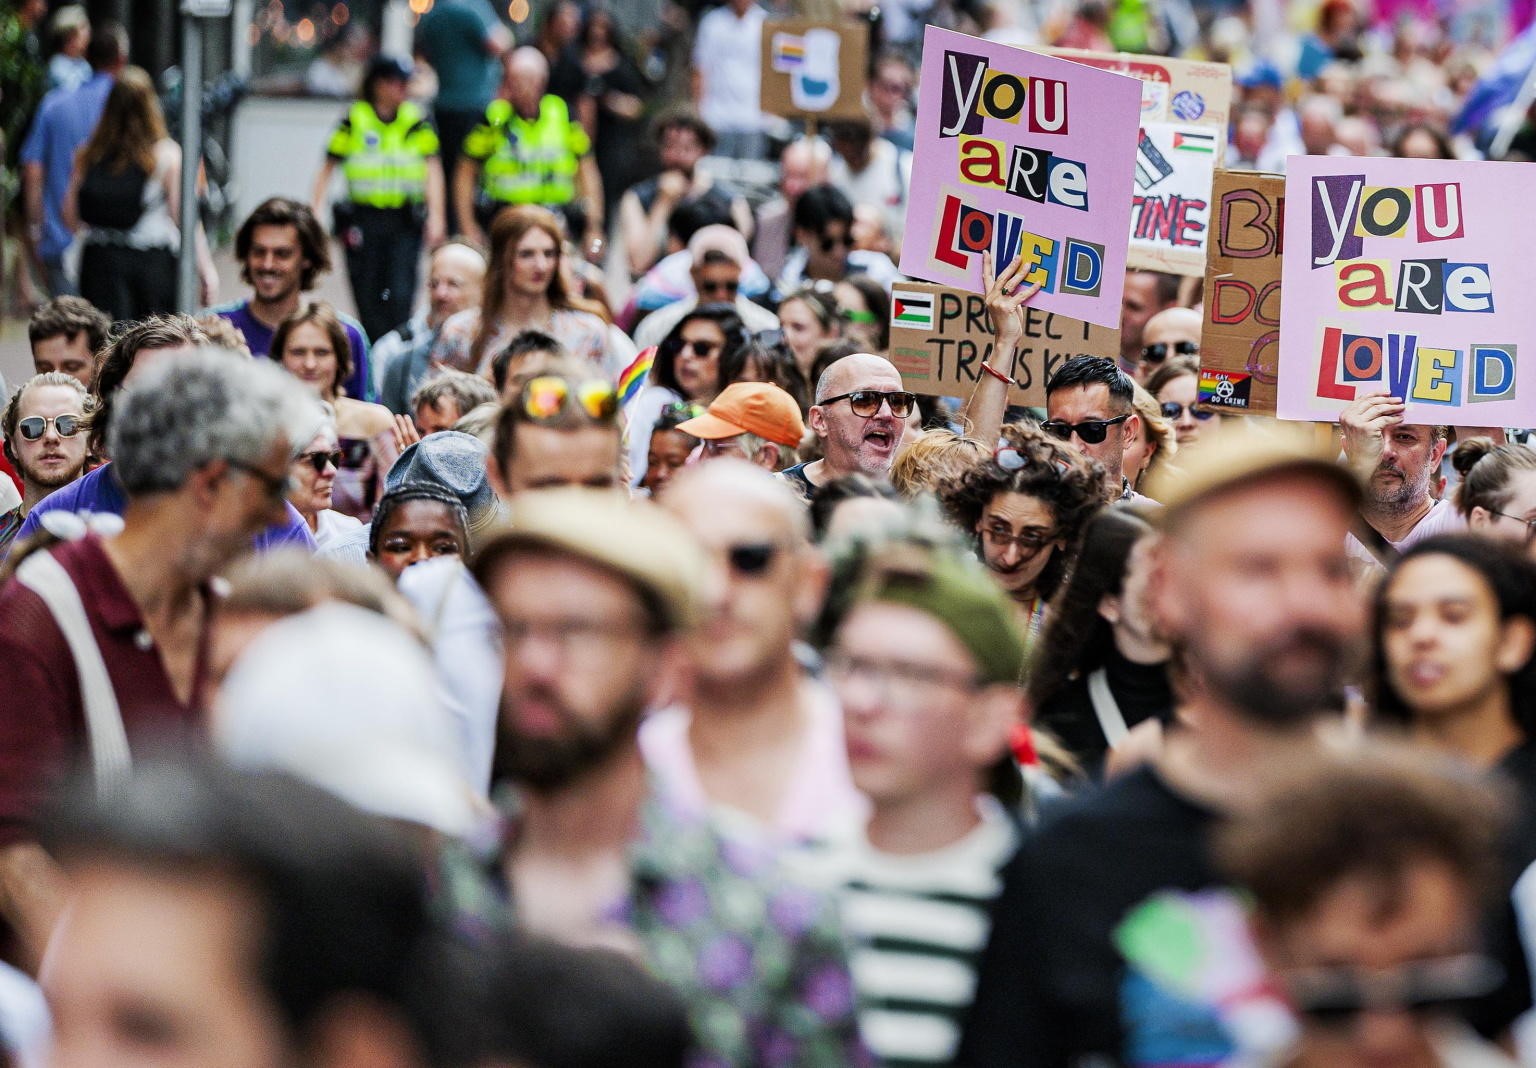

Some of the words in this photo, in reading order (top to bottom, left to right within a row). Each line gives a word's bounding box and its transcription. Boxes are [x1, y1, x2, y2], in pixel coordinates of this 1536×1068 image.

[935, 194, 1102, 292] LOVED
[1215, 373, 1229, 381] GAY
[1317, 326, 1515, 404] LOVED
[1211, 395, 1221, 403] DO
[1224, 397, 1246, 406] CRIME
